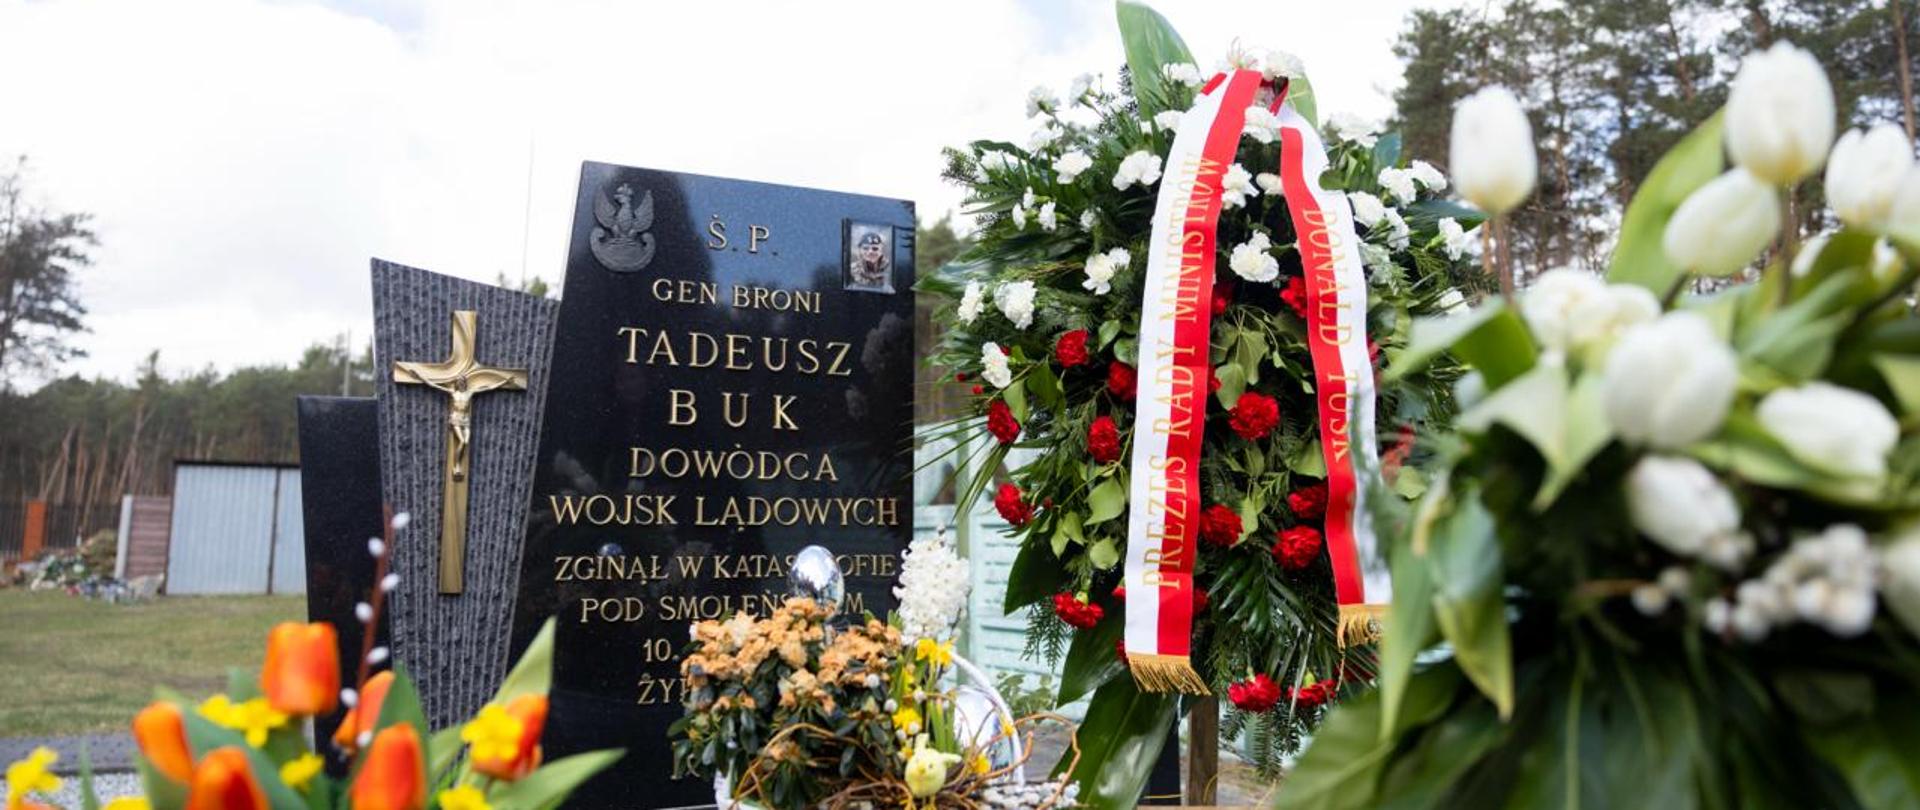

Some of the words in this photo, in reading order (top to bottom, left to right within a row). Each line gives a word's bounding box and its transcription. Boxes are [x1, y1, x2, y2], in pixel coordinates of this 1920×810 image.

[1158, 152, 1222, 323] MINISTRÓW
[652, 278, 719, 305] GEN
[732, 284, 821, 313] BRONI
[1302, 207, 1352, 347] DONALD
[617, 327, 853, 376] TADEUSZ
[1152, 339, 1196, 440] RADY
[629, 444, 838, 482] DOWÓDCA
[549, 495, 677, 526] WOJSK
[695, 496, 899, 532] LĄDOWYCH
[1142, 453, 1188, 591] PREZES
[554, 555, 669, 585] ZGINĄŁ
[677, 556, 704, 579] W
[713, 554, 896, 580] KATASOFIE
[580, 597, 644, 623] POD
[659, 589, 865, 622] SMOLEŃM
